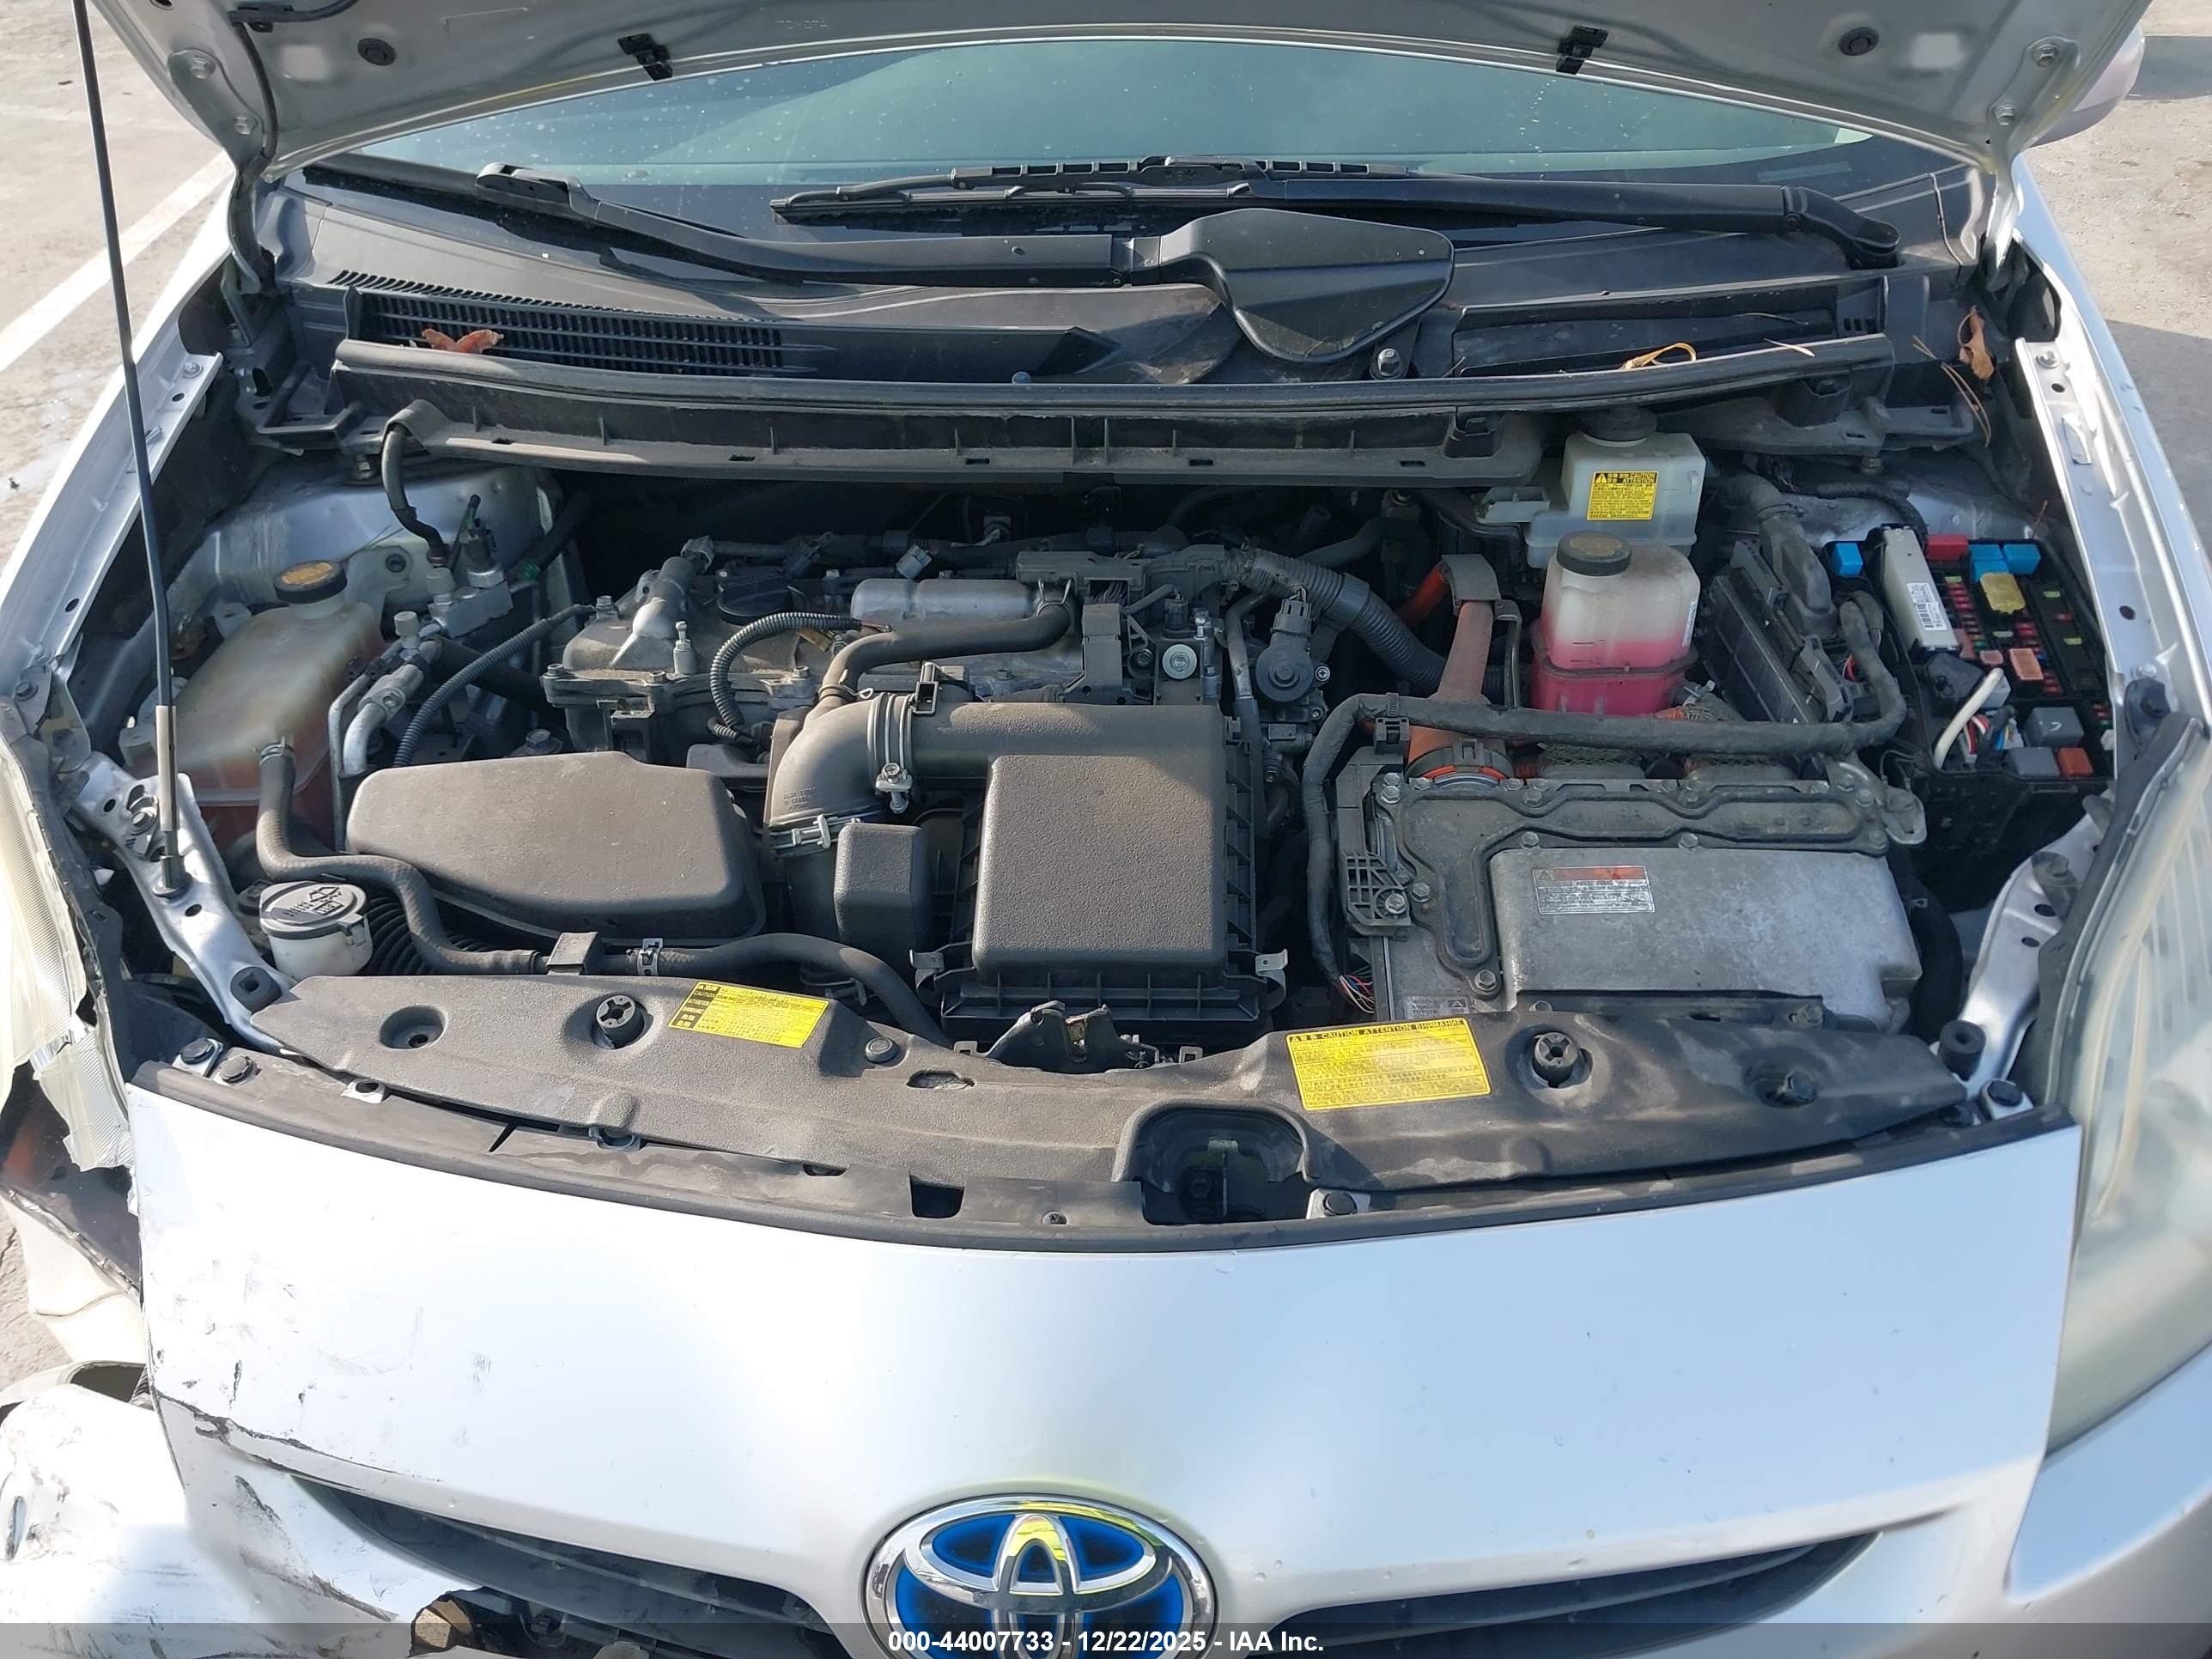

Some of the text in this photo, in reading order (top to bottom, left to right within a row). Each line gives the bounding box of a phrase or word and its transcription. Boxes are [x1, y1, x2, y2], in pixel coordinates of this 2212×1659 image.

[694, 990, 715, 999] CAUTION
[1322, 1019, 1463, 1039] CAUTION ATTENTION ВНИМАНИЕ
